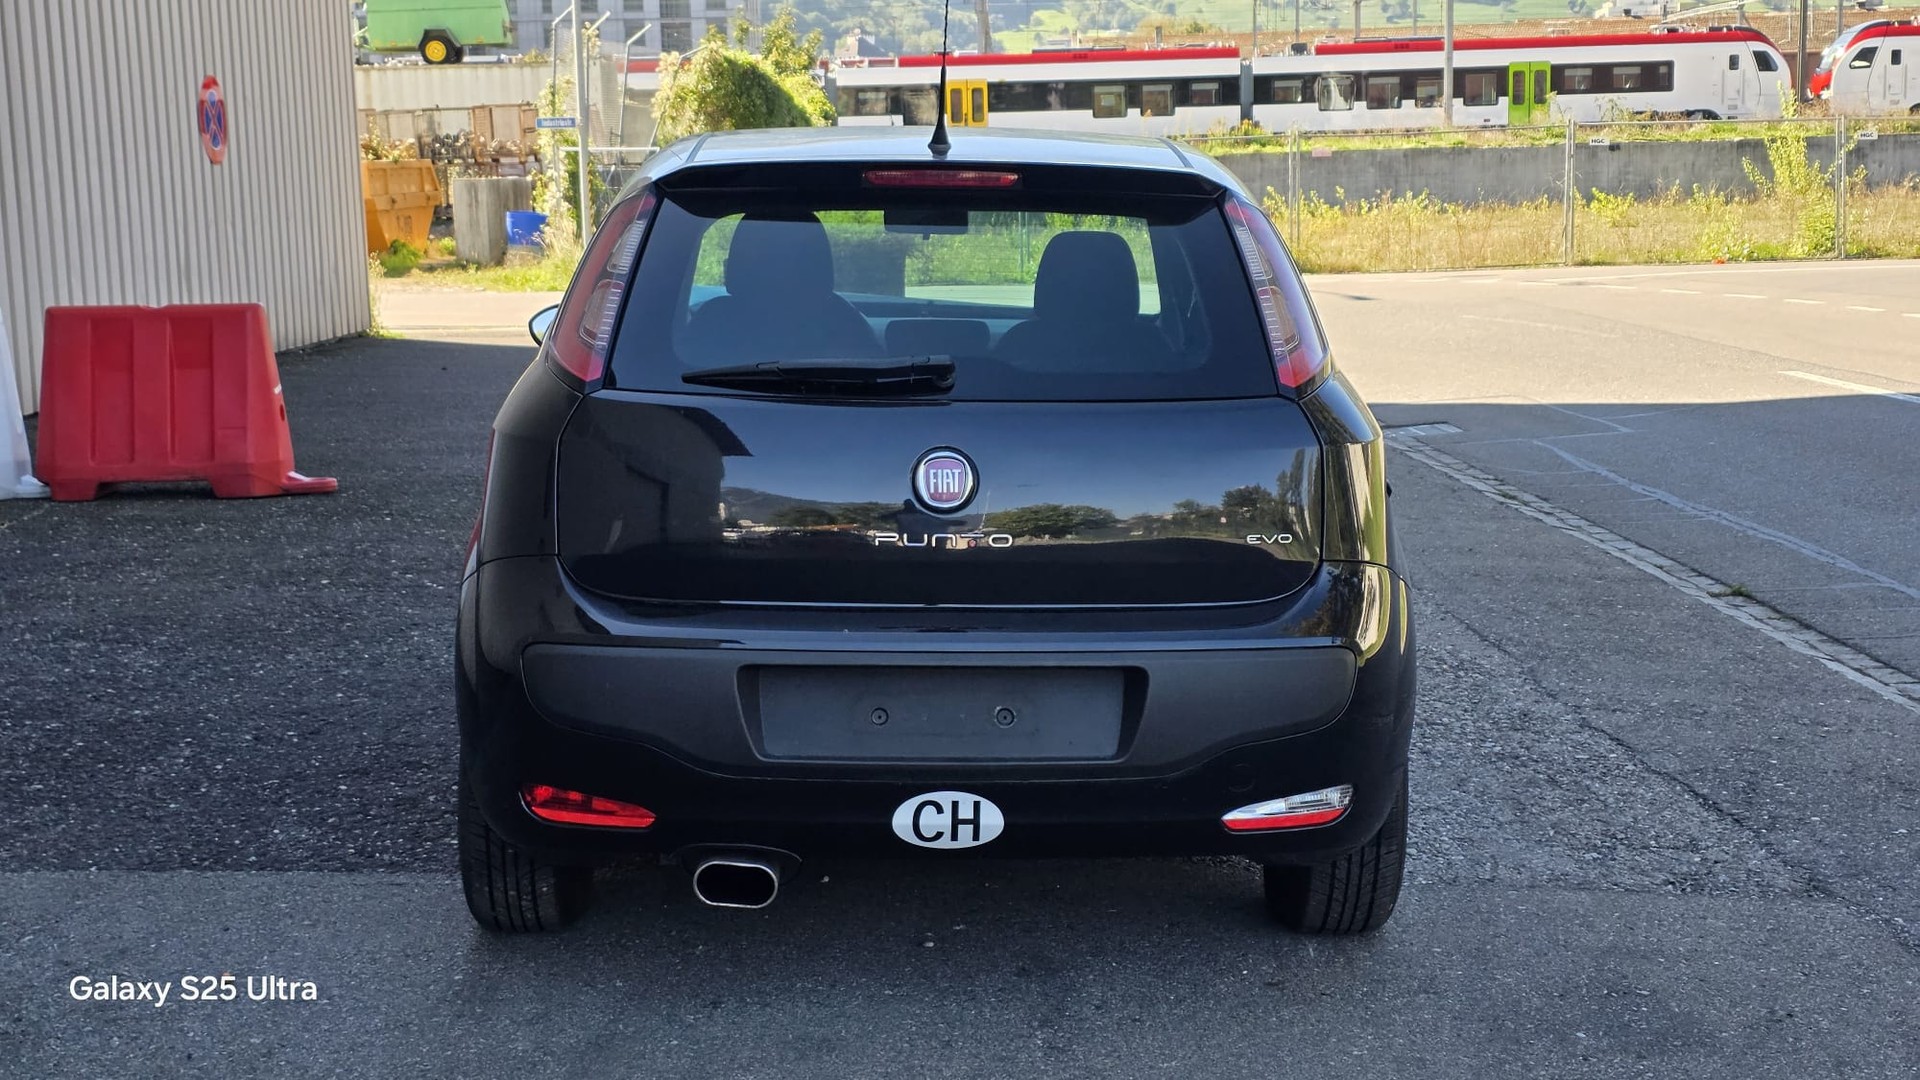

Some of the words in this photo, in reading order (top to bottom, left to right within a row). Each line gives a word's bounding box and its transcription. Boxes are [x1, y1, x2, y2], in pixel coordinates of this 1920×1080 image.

[929, 468, 962, 494] FIAT
[1246, 533, 1293, 544] EVO
[912, 799, 982, 843] CH
